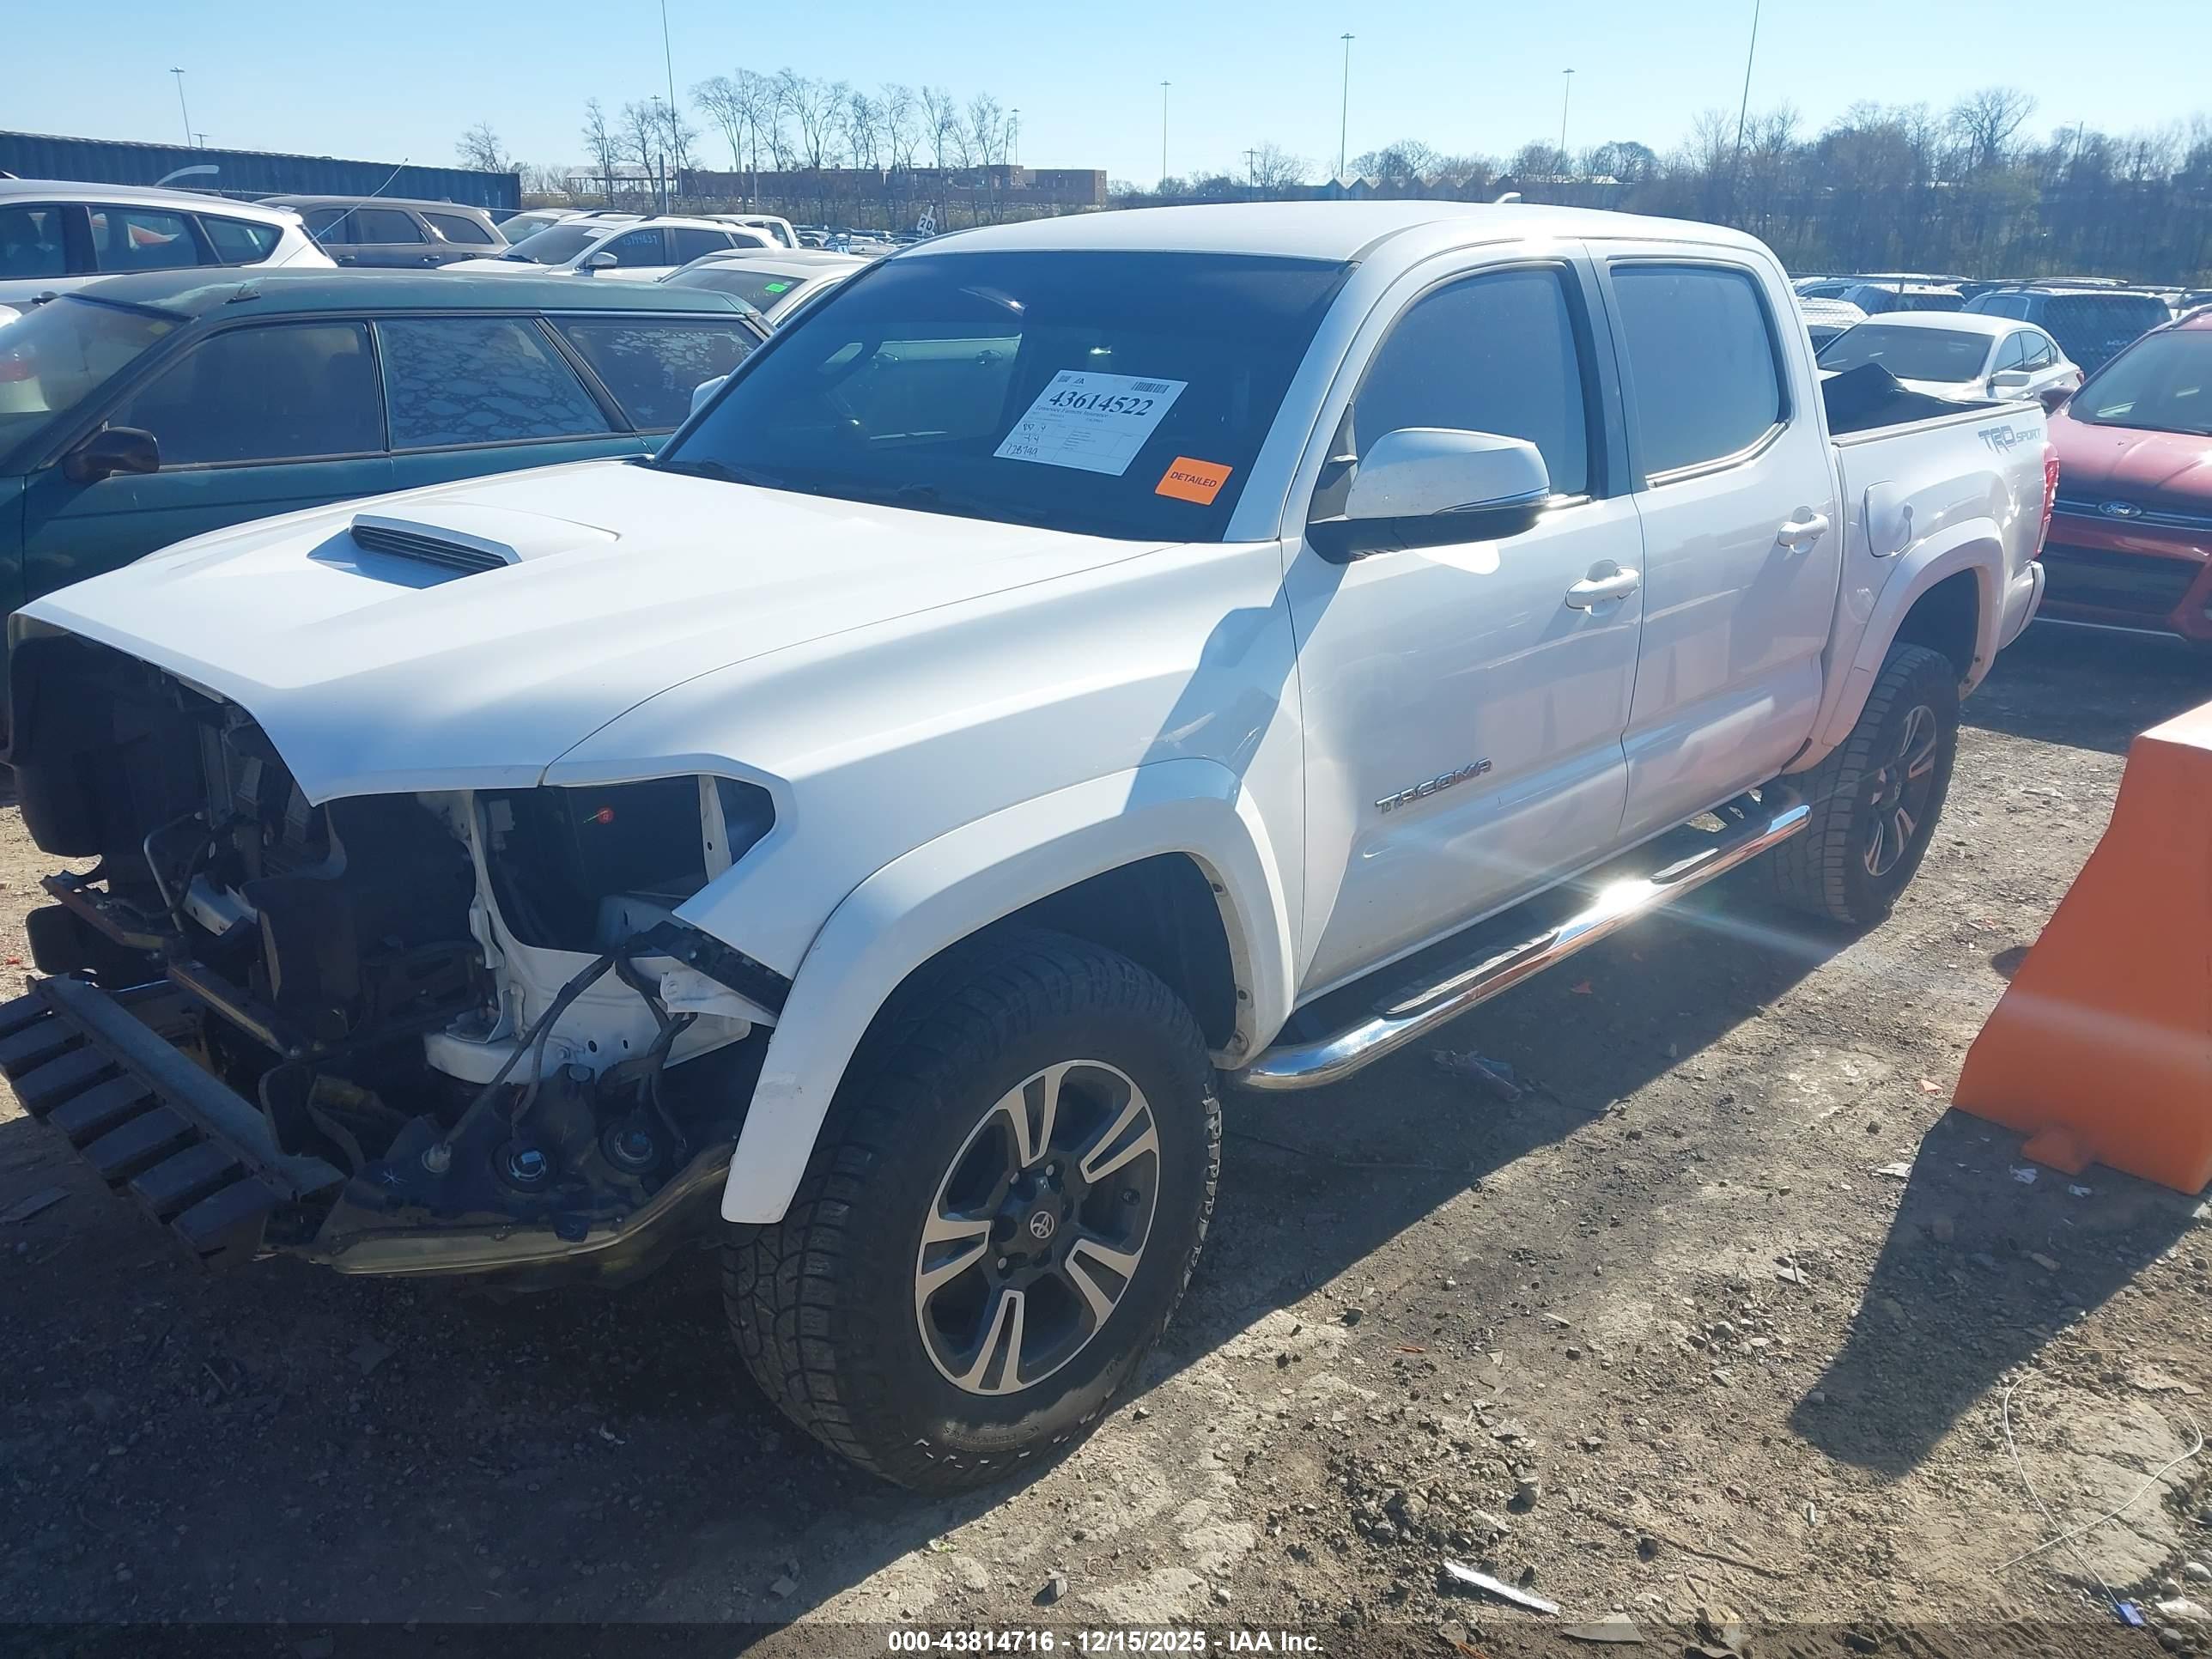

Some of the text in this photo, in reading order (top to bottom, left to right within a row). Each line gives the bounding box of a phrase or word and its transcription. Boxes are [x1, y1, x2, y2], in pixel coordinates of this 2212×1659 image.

[919, 217, 933, 231] 20
[1048, 390, 1154, 416] 43614522
[1978, 425, 2041, 454] TRD SPORT
[1170, 471, 1218, 488] DETAILED
[2106, 504, 2131, 515] Ford
[1374, 757, 1492, 813] TACOMA
